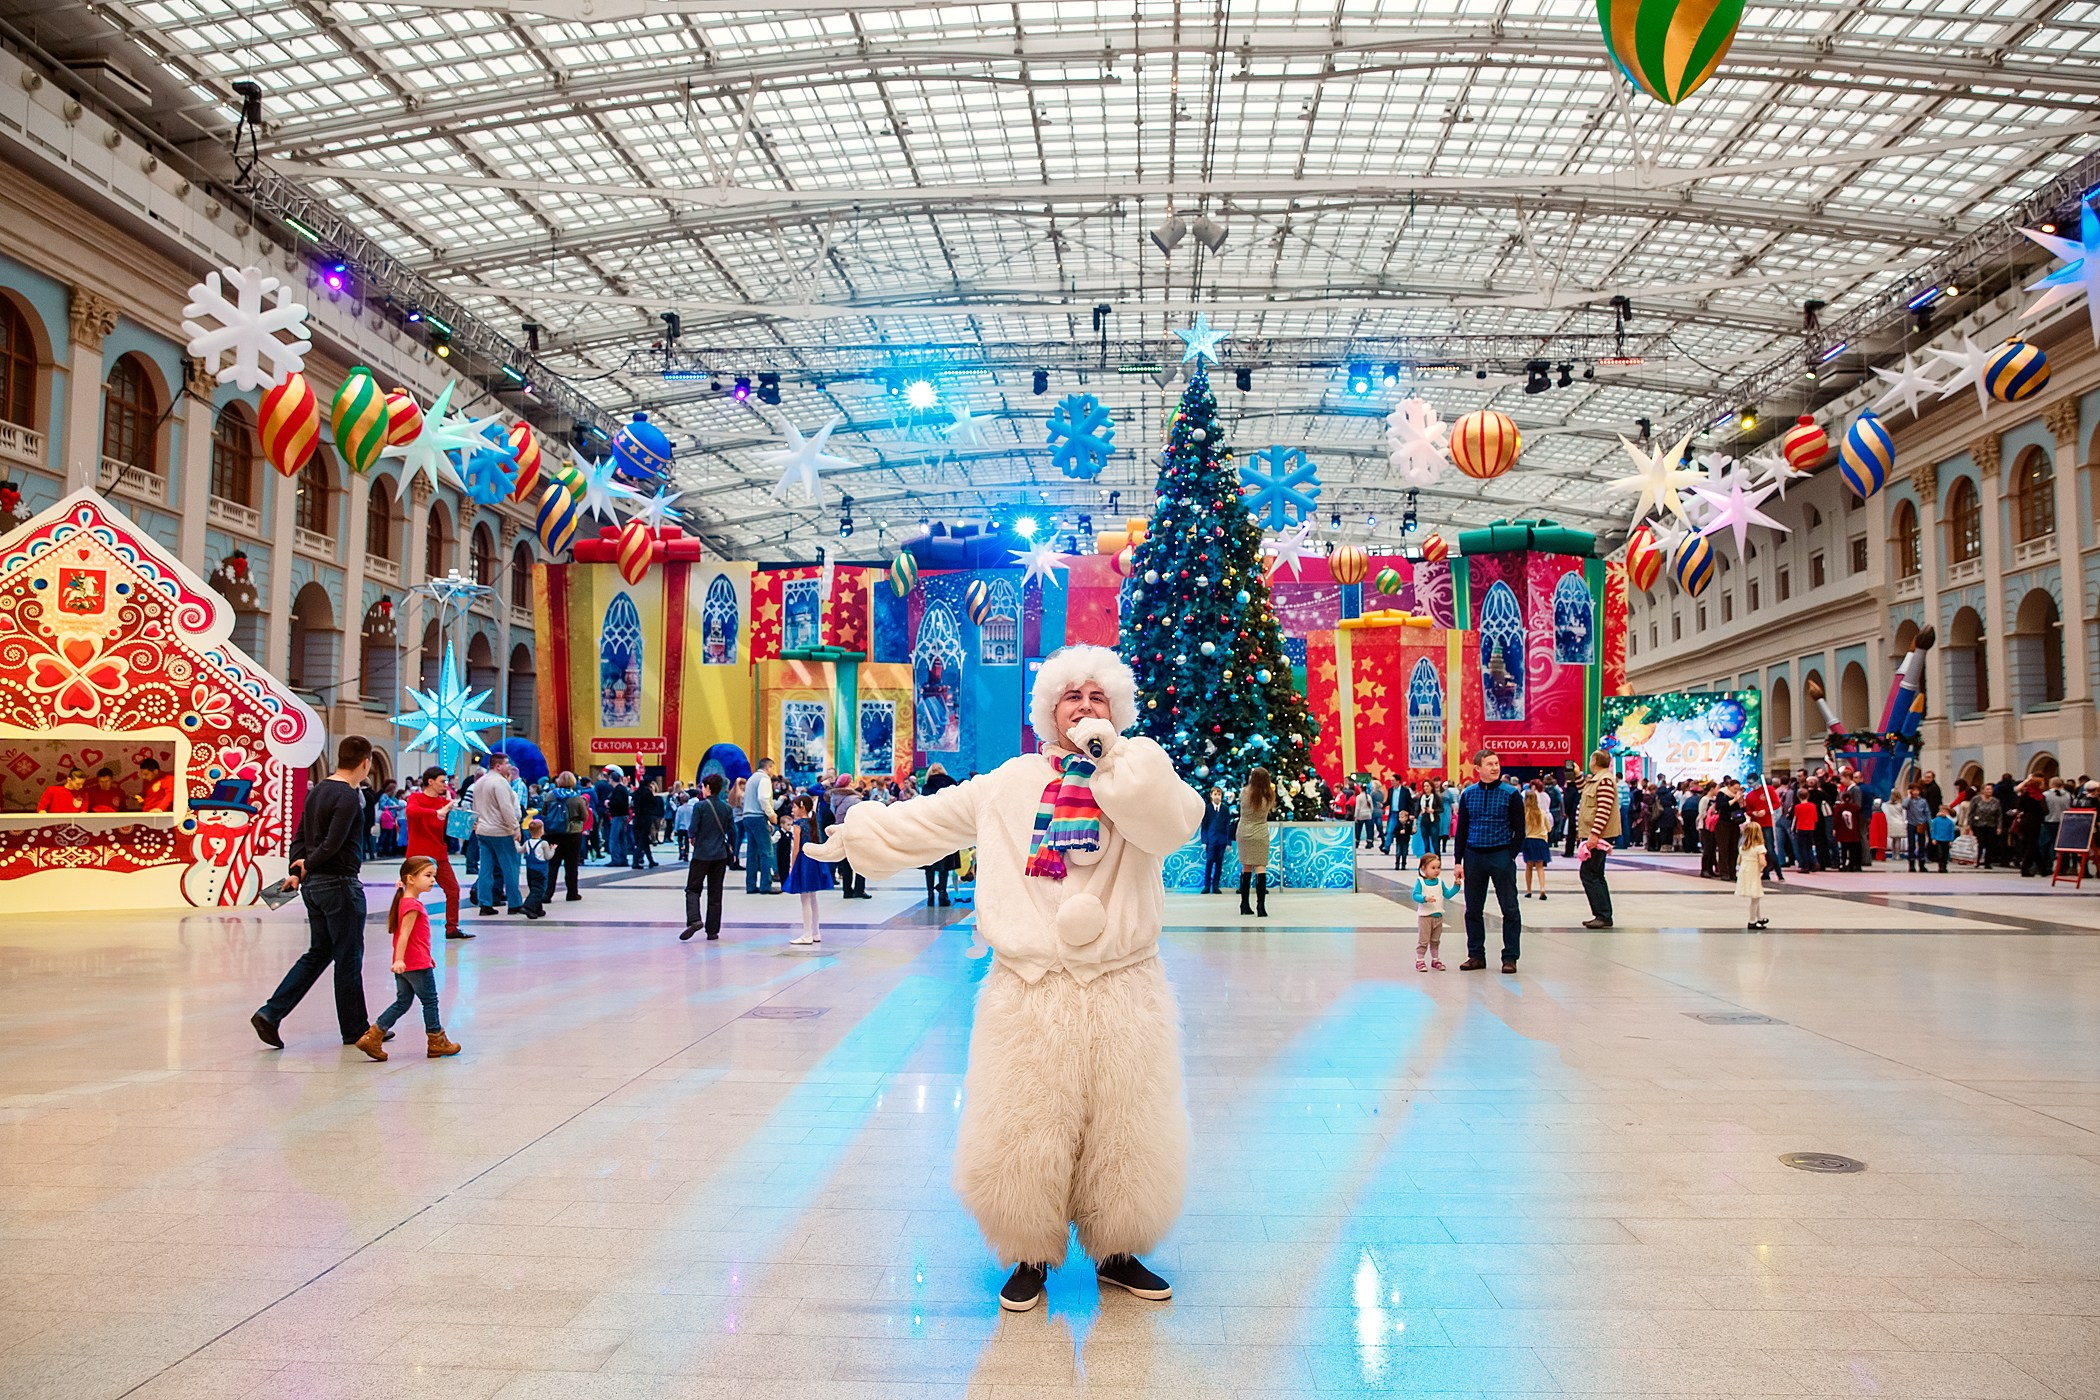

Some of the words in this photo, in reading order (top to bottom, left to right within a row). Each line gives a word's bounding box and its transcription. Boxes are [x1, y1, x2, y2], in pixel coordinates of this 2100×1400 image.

[592, 741, 632, 750] СЕКТОРА
[635, 741, 664, 751] 1,2,3,4
[1484, 740, 1529, 750] СЕКТОРА
[1531, 740, 1568, 750] 7,8,9,10
[1665, 741, 1731, 763] 2017
